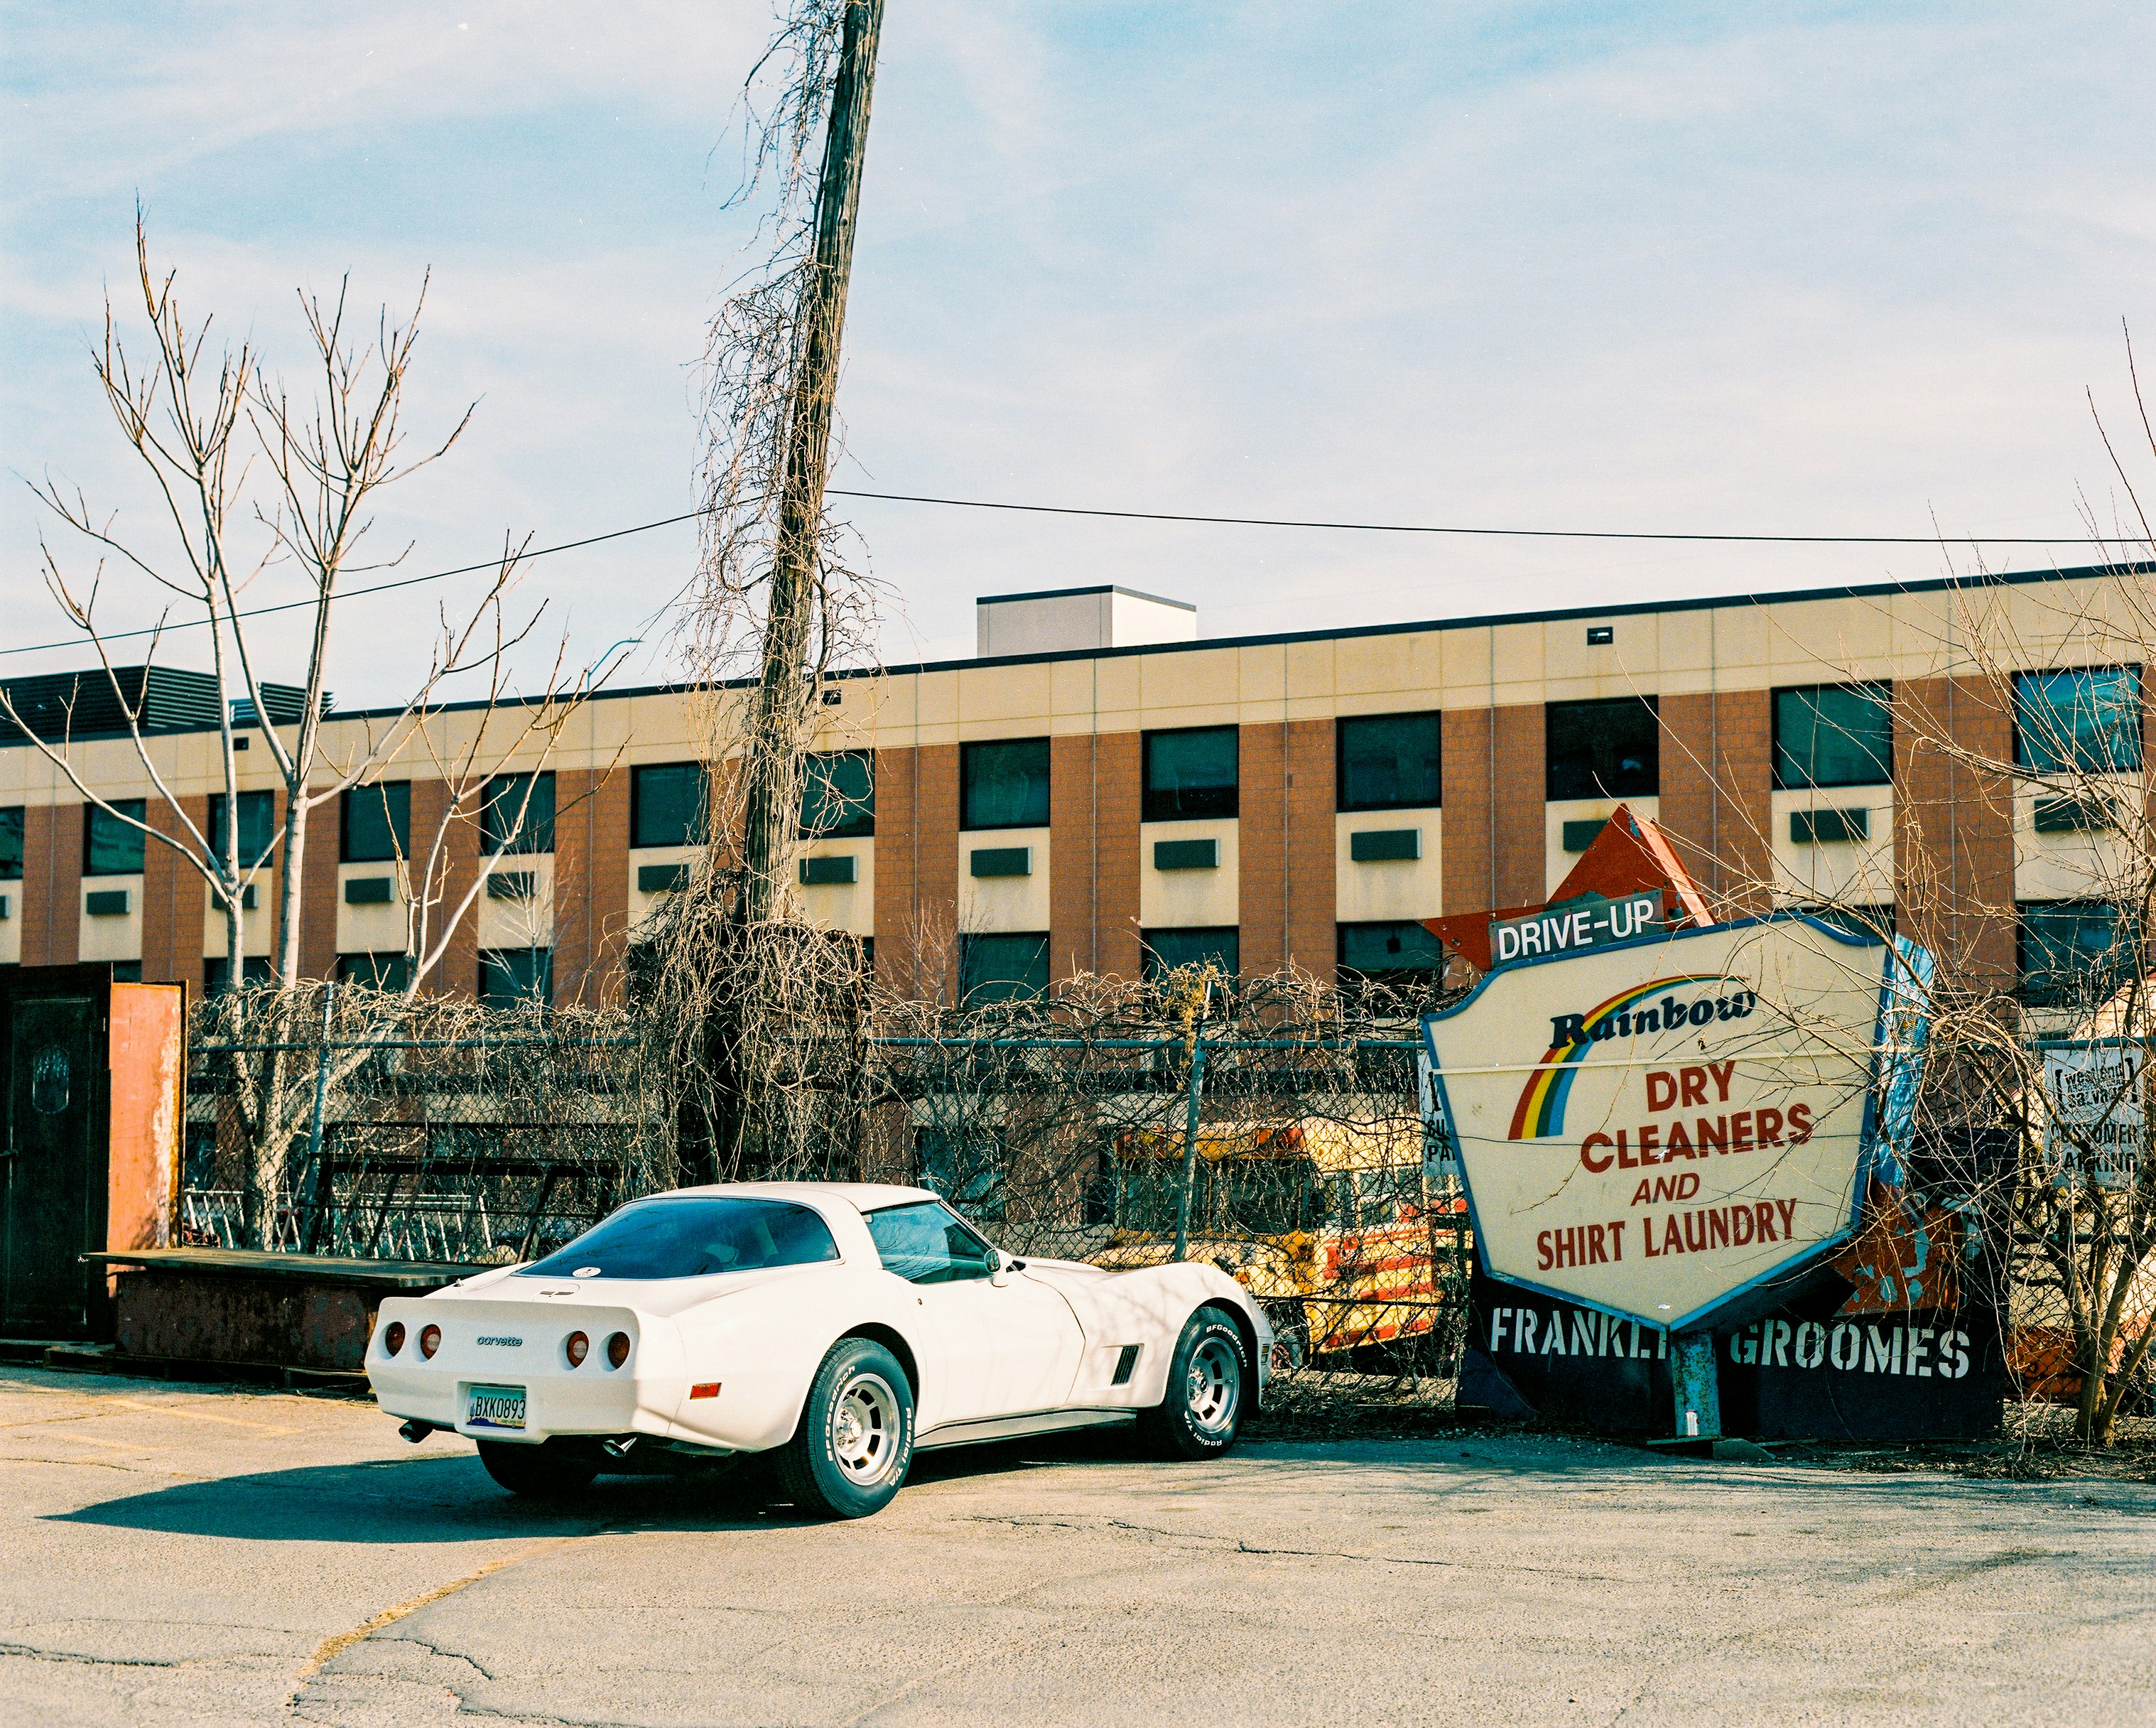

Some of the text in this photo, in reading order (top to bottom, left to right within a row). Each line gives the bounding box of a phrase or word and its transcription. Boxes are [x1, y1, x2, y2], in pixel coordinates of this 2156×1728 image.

[1498, 899, 1654, 961] DRIVE-UP
[1549, 991, 1756, 1049] Rainbow
[1646, 1060, 1735, 1113] DRY
[1581, 1103, 1814, 1174] CLEANERS
[1630, 1172, 1701, 1207] AND
[1537, 1198, 1797, 1271] SHIRT LAUNDRY
[477, 1336, 523, 1347] corvette
[1729, 1319, 1971, 1379] GROOMES
[475, 1396, 526, 1420] BXK0893
